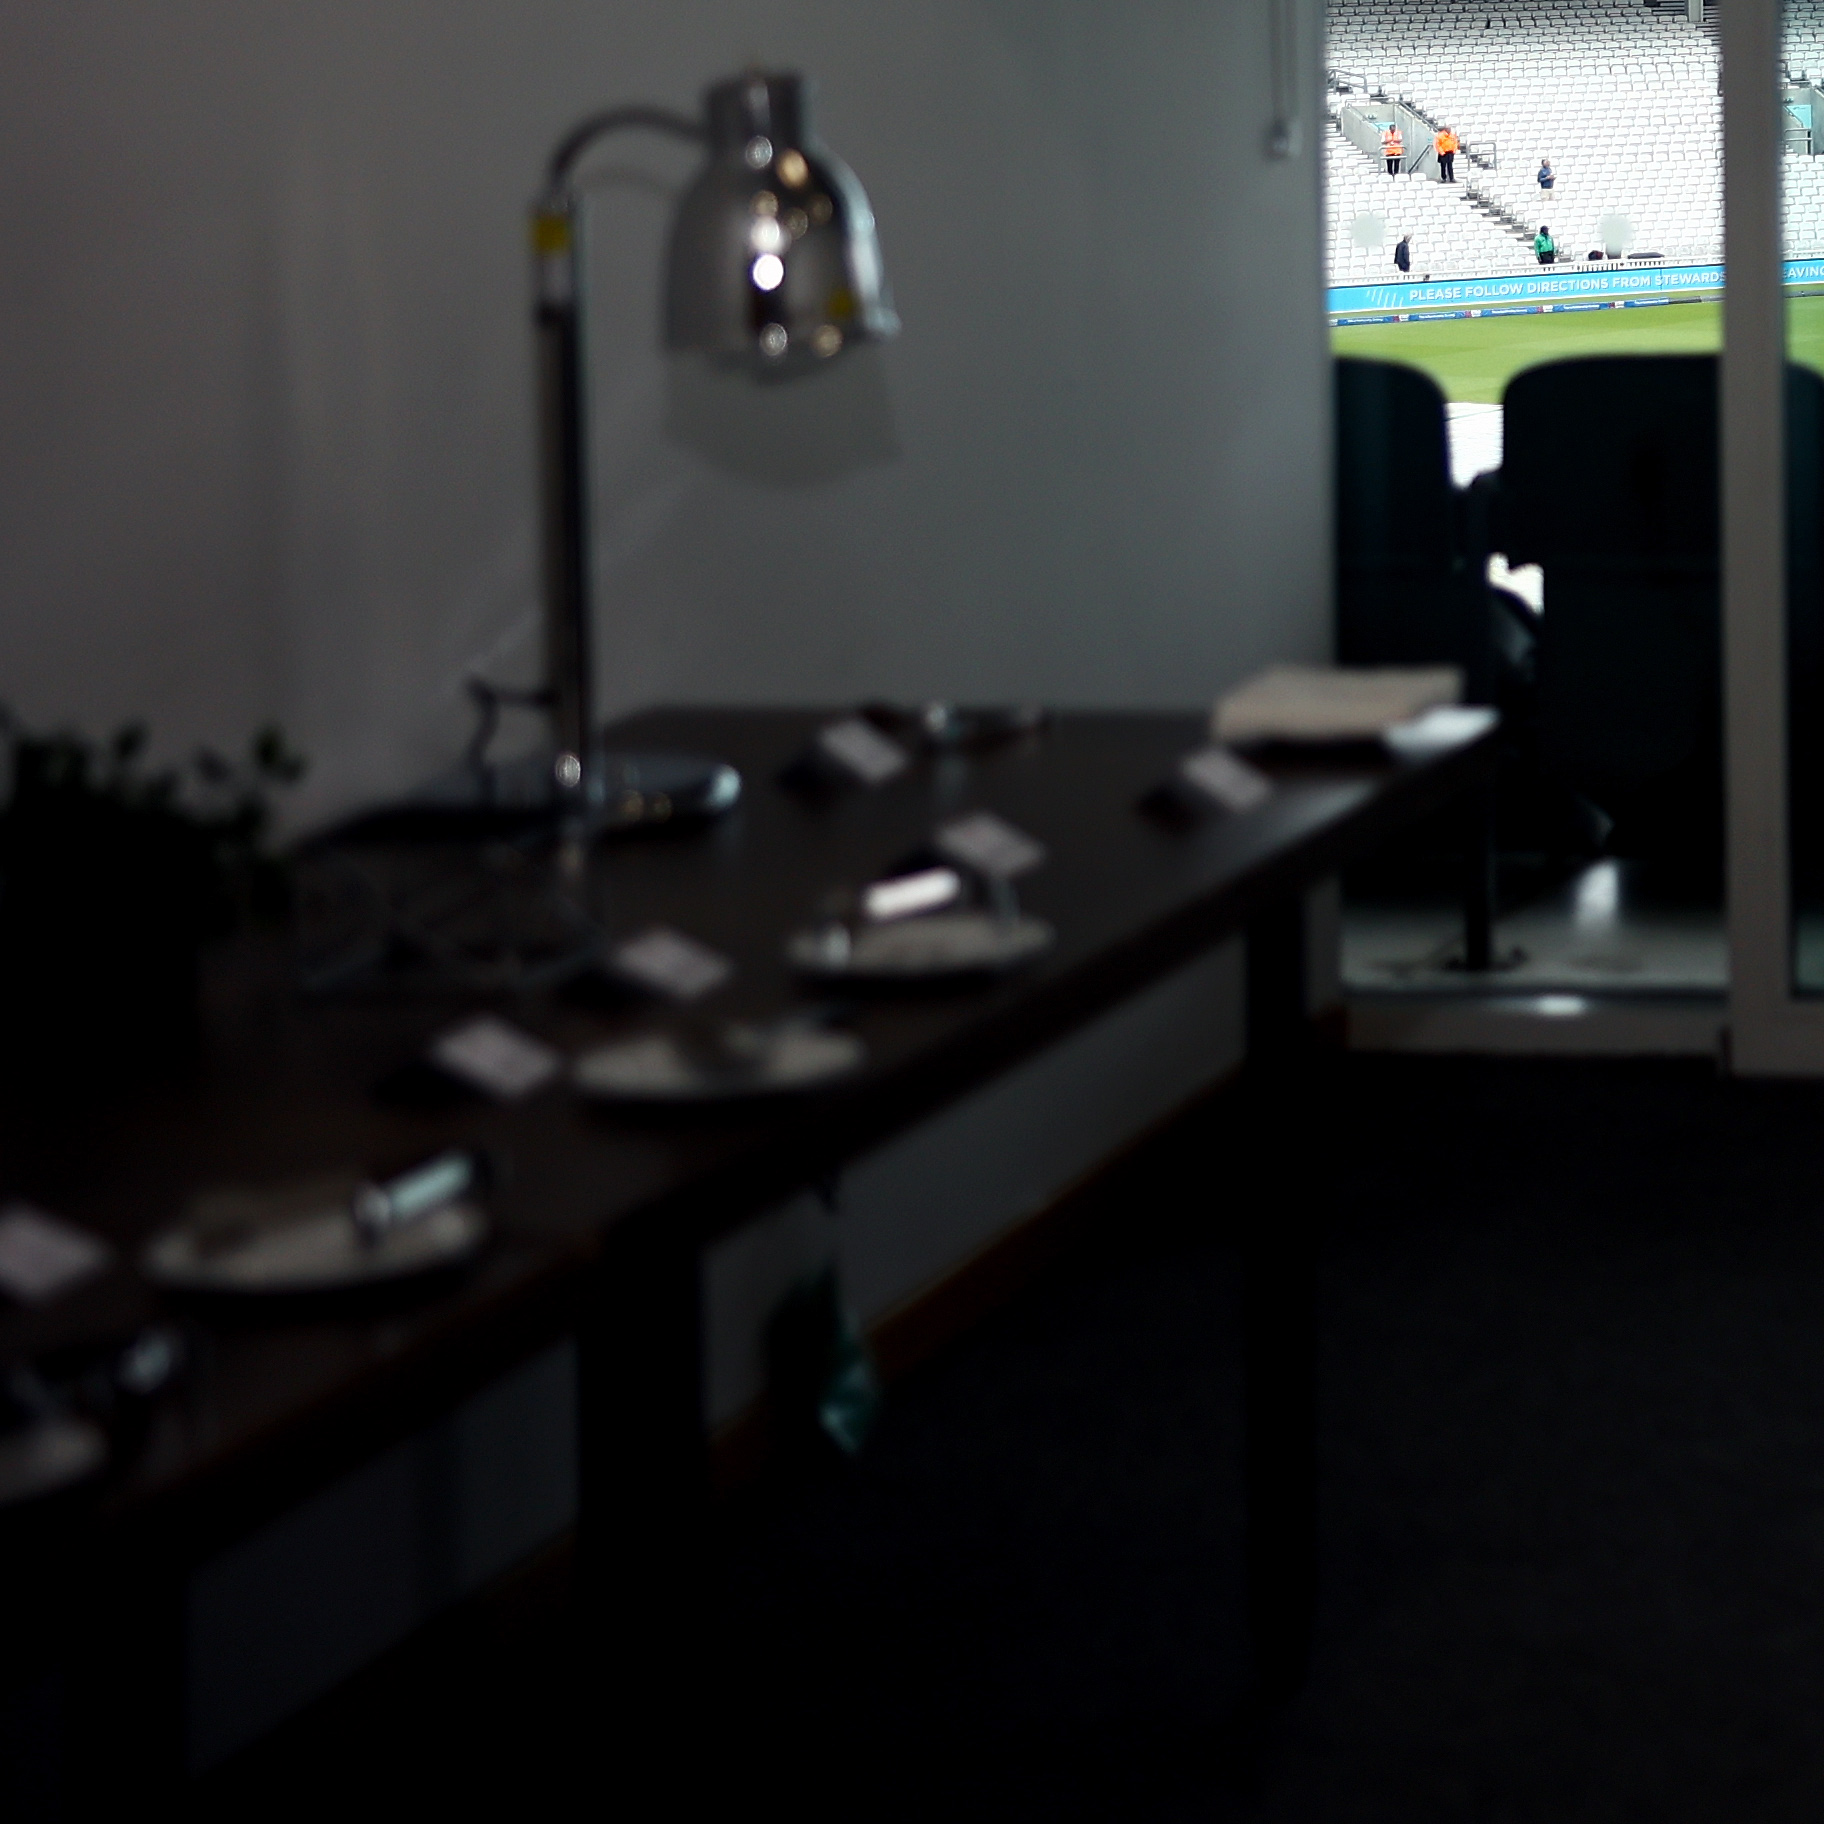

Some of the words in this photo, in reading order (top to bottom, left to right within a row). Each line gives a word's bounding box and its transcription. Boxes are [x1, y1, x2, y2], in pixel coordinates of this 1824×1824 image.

[1409, 286, 1462, 301] PLEASE
[1465, 283, 1524, 298] FOLLOW
[1528, 278, 1609, 294] DIRECTIONS
[1612, 275, 1651, 289] FROM
